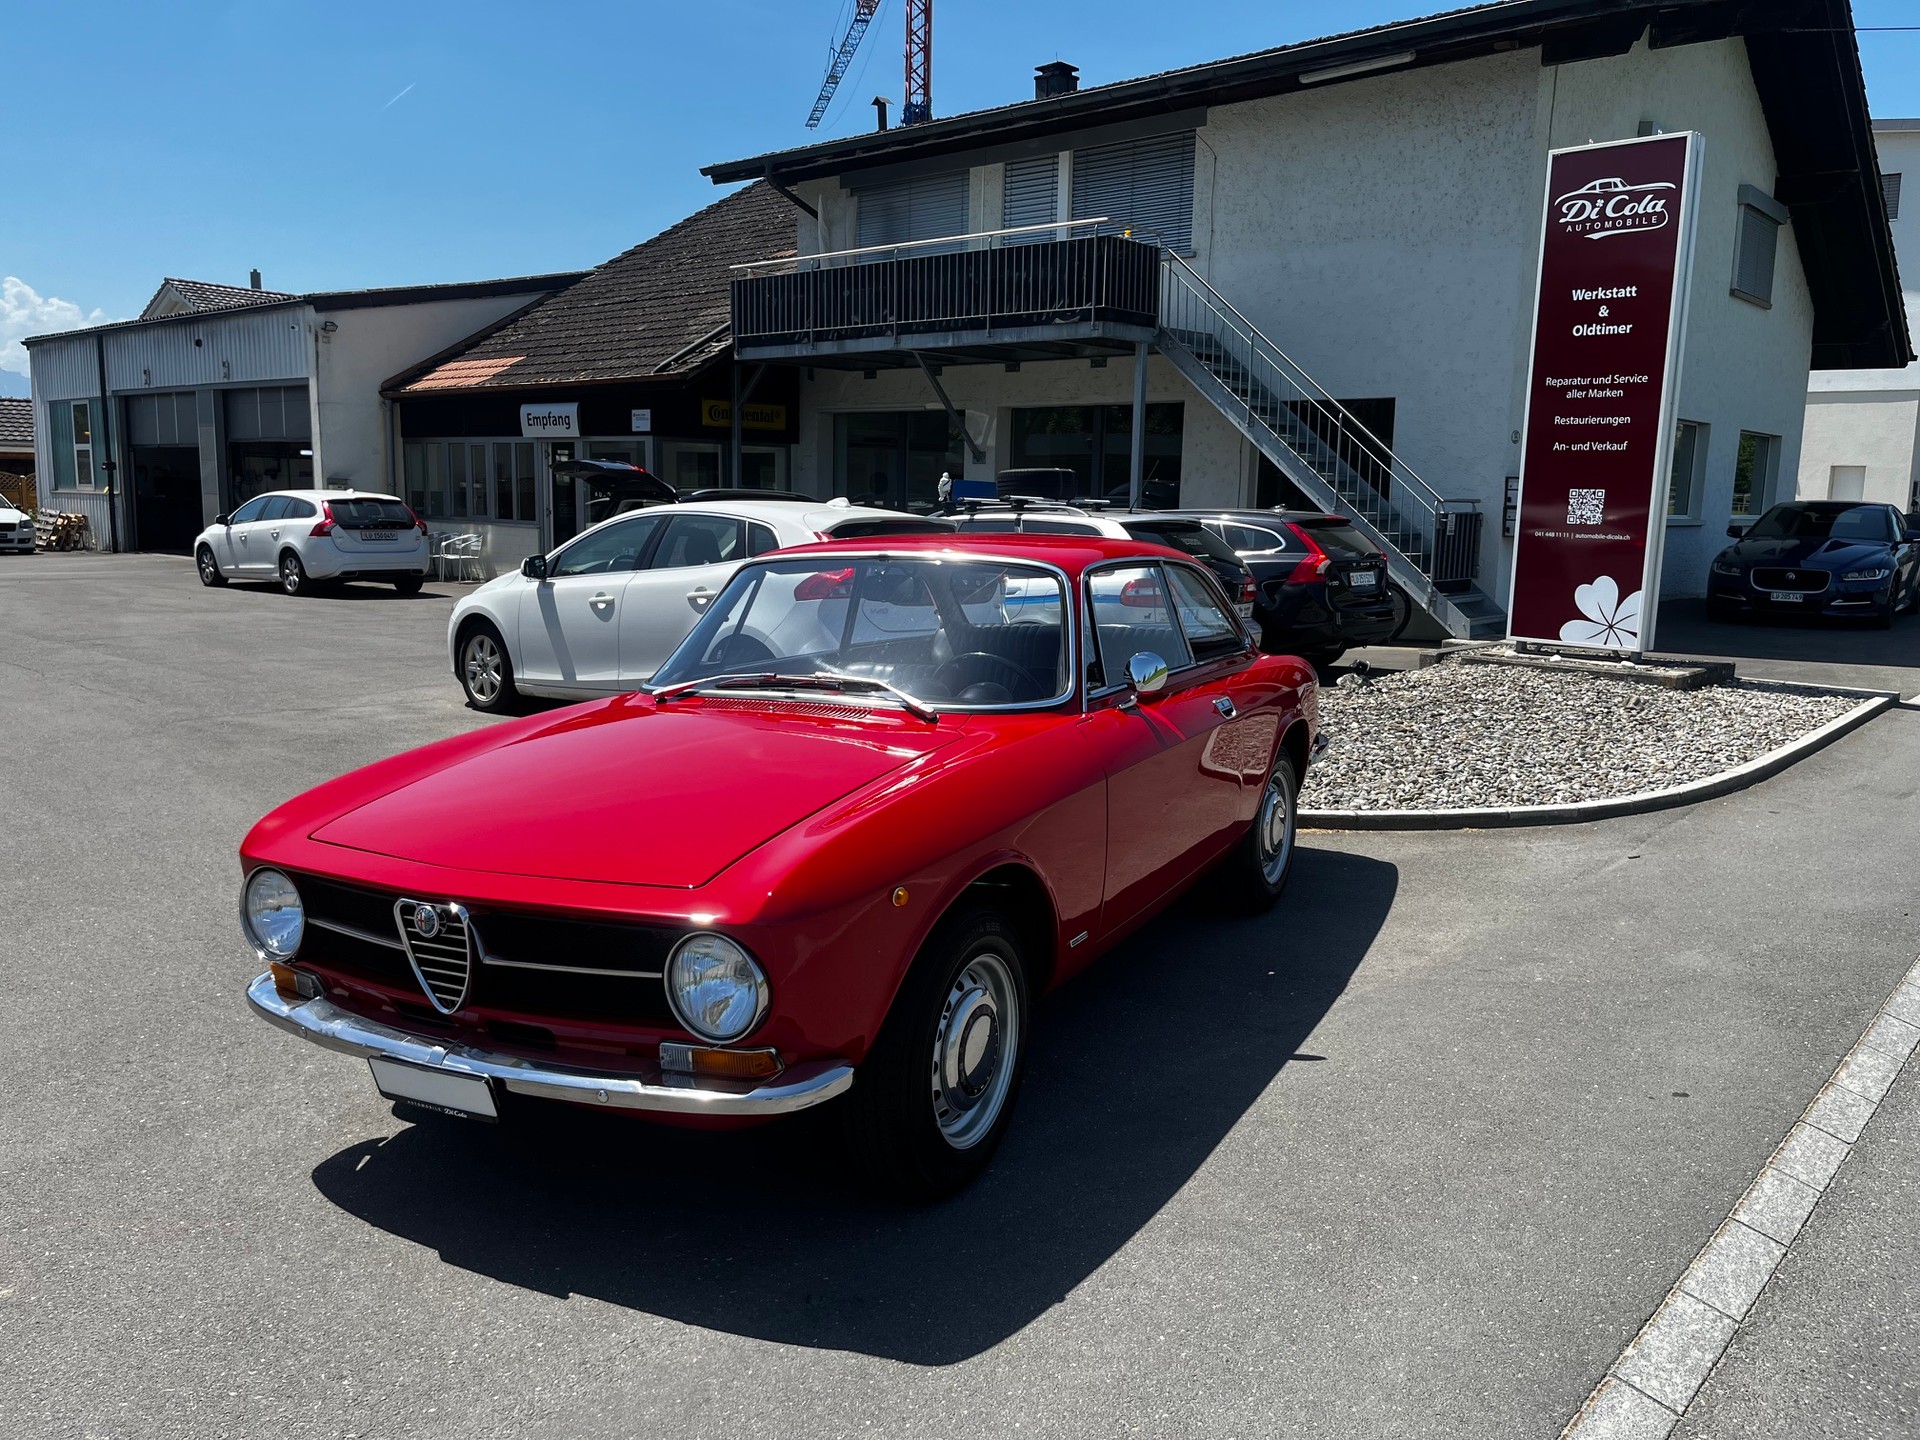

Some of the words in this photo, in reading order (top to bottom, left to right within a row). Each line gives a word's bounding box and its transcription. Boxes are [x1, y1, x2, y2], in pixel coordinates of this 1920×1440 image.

[1559, 198, 1604, 224] Di
[1605, 194, 1667, 219] Cola
[1566, 215, 1658, 233] AUTOMOBILE
[1572, 285, 1638, 301] Werkstatt
[1598, 305, 1610, 317] &
[1572, 323, 1633, 337] Oldtimer
[1545, 375, 1591, 388] Reparatur
[1592, 375, 1611, 385] und
[1613, 373, 1649, 385] Service
[1566, 388, 1587, 399] aller
[1588, 388, 1624, 398] Marken
[526, 411, 571, 430] Empfang
[1554, 415, 1631, 426] Restaurierungen
[1553, 441, 1569, 451] An-
[1571, 441, 1590, 451] und
[1591, 440, 1628, 451] Verkauf
[1575, 532, 1631, 541] automobile-dicola.ch
[407, 1100, 442, 1112] AUTOMOBILE
[453, 1110, 468, 1119] Cola
